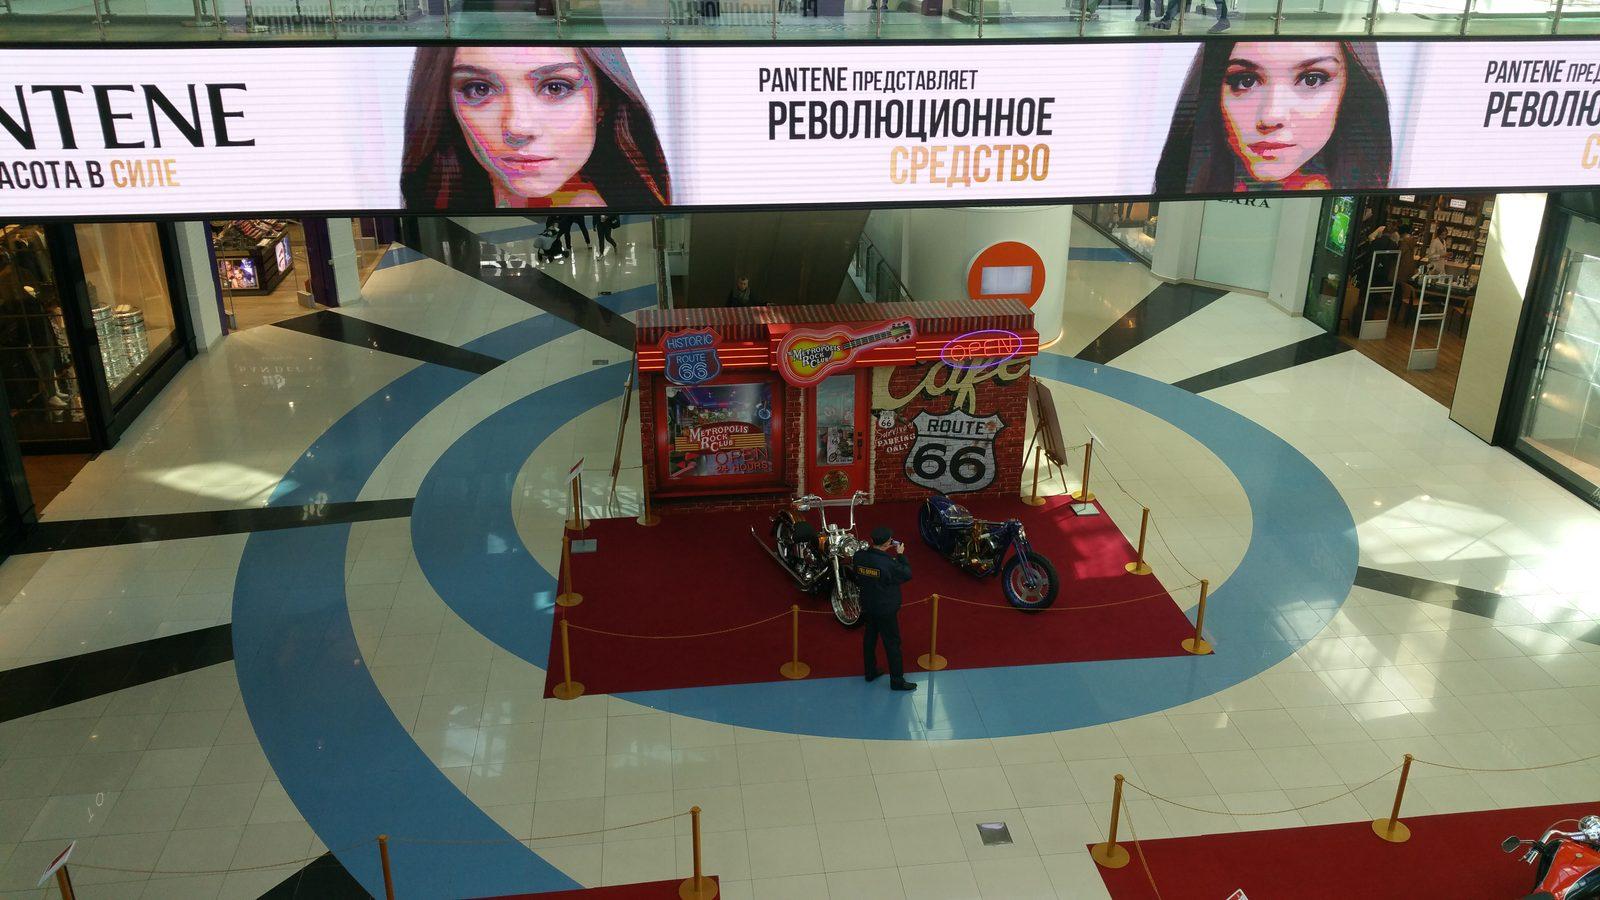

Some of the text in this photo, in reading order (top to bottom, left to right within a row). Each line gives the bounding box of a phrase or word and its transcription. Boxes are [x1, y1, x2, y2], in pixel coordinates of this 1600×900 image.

[1485, 60, 1566, 83] PANTENE
[759, 67, 978, 93] PANTENE ПРЕДСТАВЛЯЕТ
[768, 97, 1056, 142] РЕВОЛЮЦИОННОЕ
[86, 160, 105, 188] В
[110, 159, 180, 188] СИЛЕ
[889, 143, 1051, 188] СРЕДСТВО
[666, 334, 713, 350] HISTORIC
[951, 334, 1013, 361] OPEN
[676, 353, 706, 364] ROUTE
[793, 344, 841, 360] METROPOLIS
[802, 352, 825, 367] ROCK
[678, 362, 708, 380] 66
[881, 419, 892, 427] 66
[927, 418, 986, 435] ROUTE
[690, 426, 749, 442] METROPOLIS
[700, 434, 728, 450] ROCK
[877, 433, 916, 447] PARKING
[710, 440, 733, 452] CLUB
[886, 443, 909, 453] ONLY
[715, 448, 768, 465] OPEN
[912, 442, 986, 484] 66
[733, 460, 768, 472] HOURS
